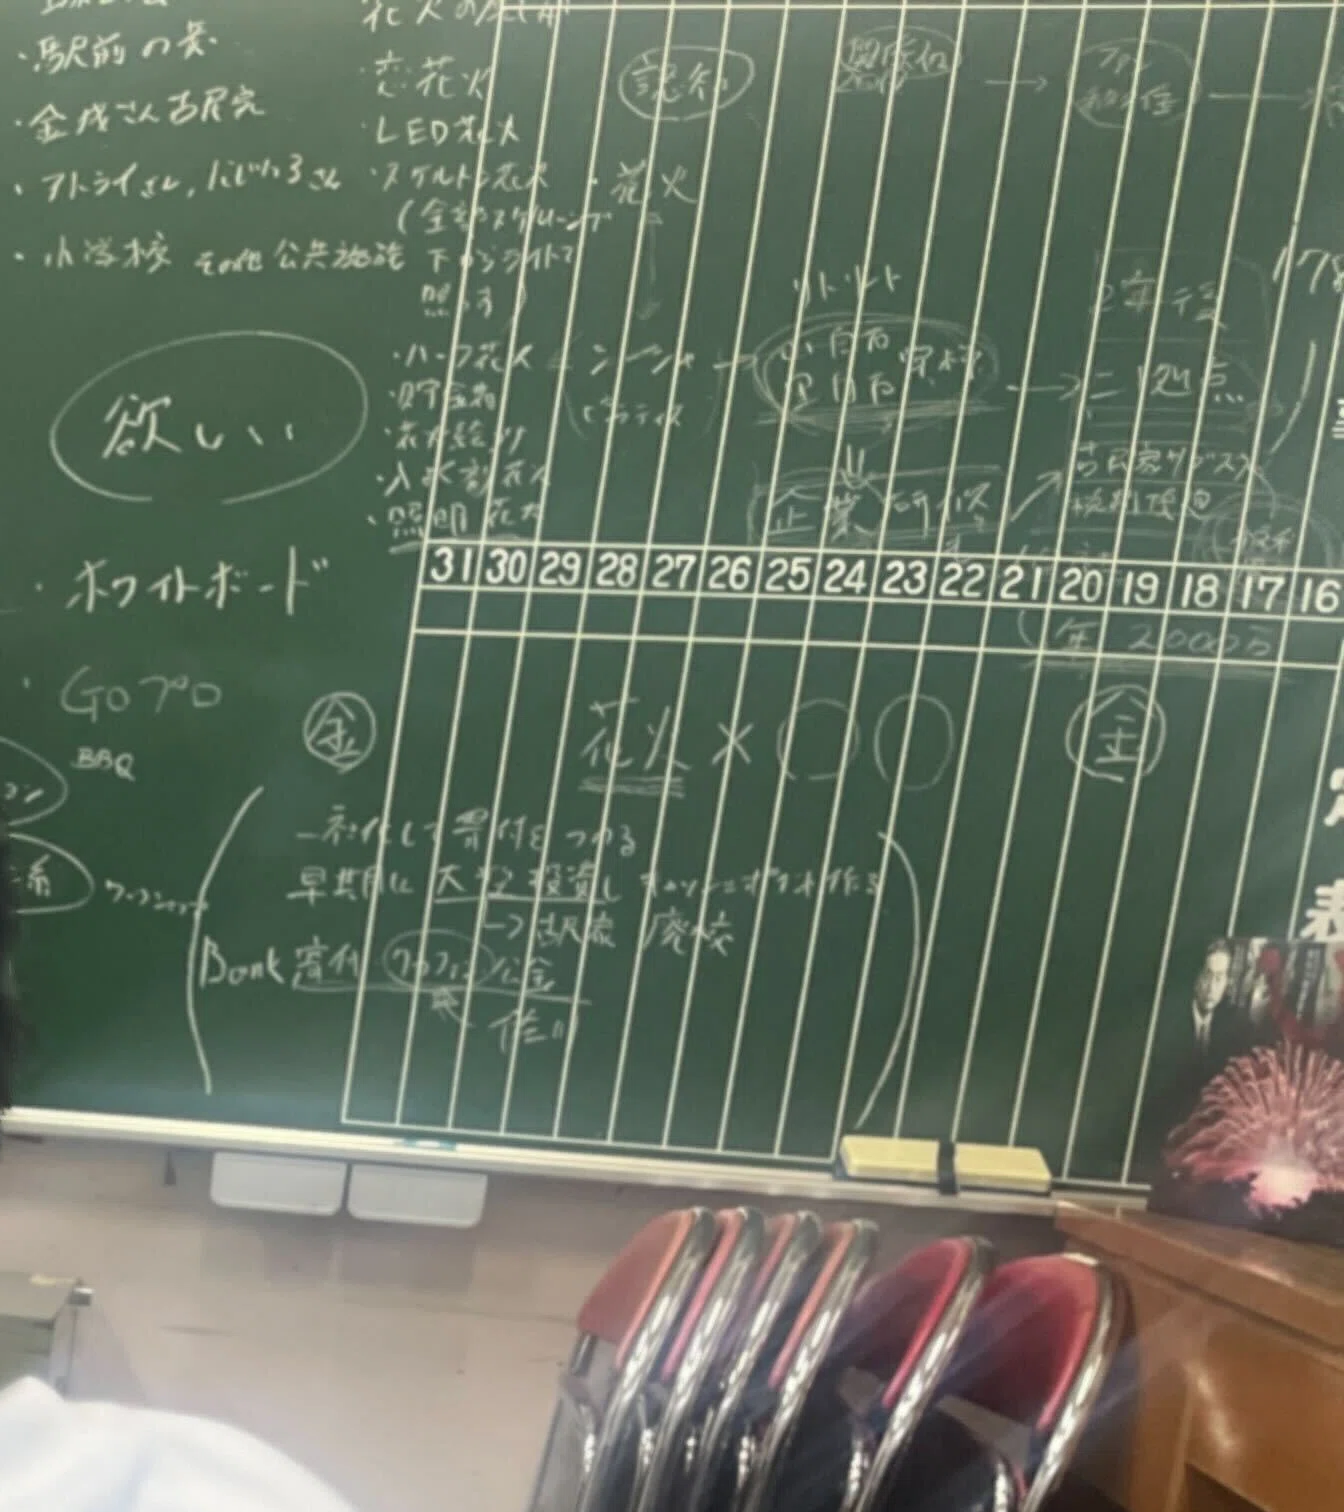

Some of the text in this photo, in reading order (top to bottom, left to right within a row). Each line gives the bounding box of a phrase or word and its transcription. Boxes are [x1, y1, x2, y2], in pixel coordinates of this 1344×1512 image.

[101, 394, 297, 460] 欲しい
[66, 545, 330, 615] ホワイトボード
[430, 546, 1342, 615] 31 30 29 28 27 26 25 24 23 22 21 20 19 18 17 16
